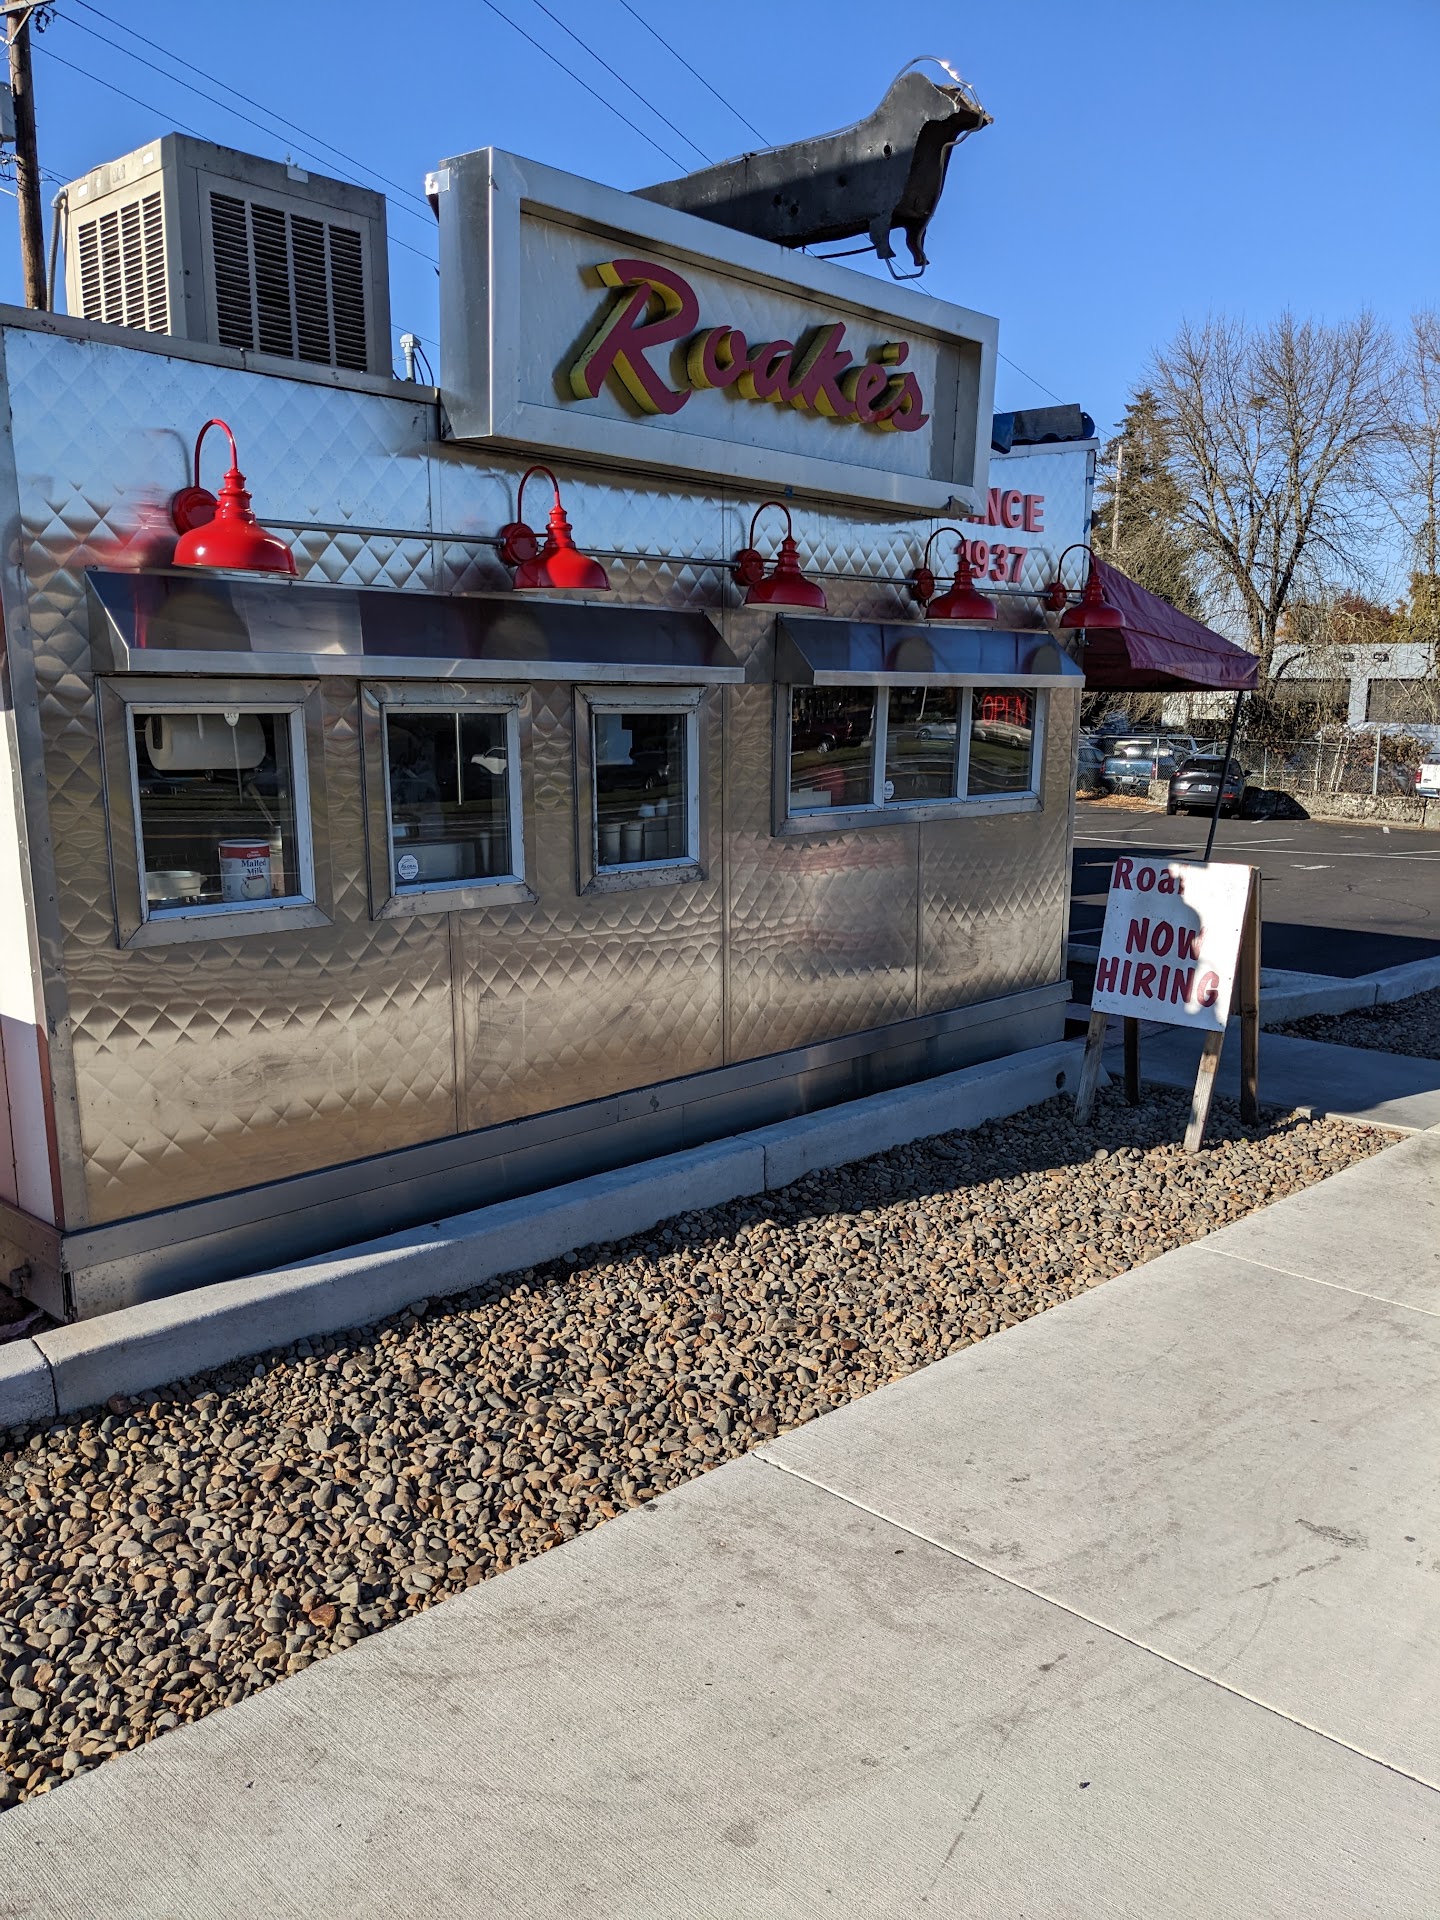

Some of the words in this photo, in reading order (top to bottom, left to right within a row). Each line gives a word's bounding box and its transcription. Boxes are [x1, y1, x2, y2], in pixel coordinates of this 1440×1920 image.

[570, 259, 930, 432] Roake's
[967, 487, 1045, 532] NCE
[982, 695, 1027, 726] OPEN
[241, 859, 267, 868] Malted
[247, 867, 264, 876] Milk
[1126, 917, 1206, 961] NOW
[1096, 956, 1220, 1008] HIRING
